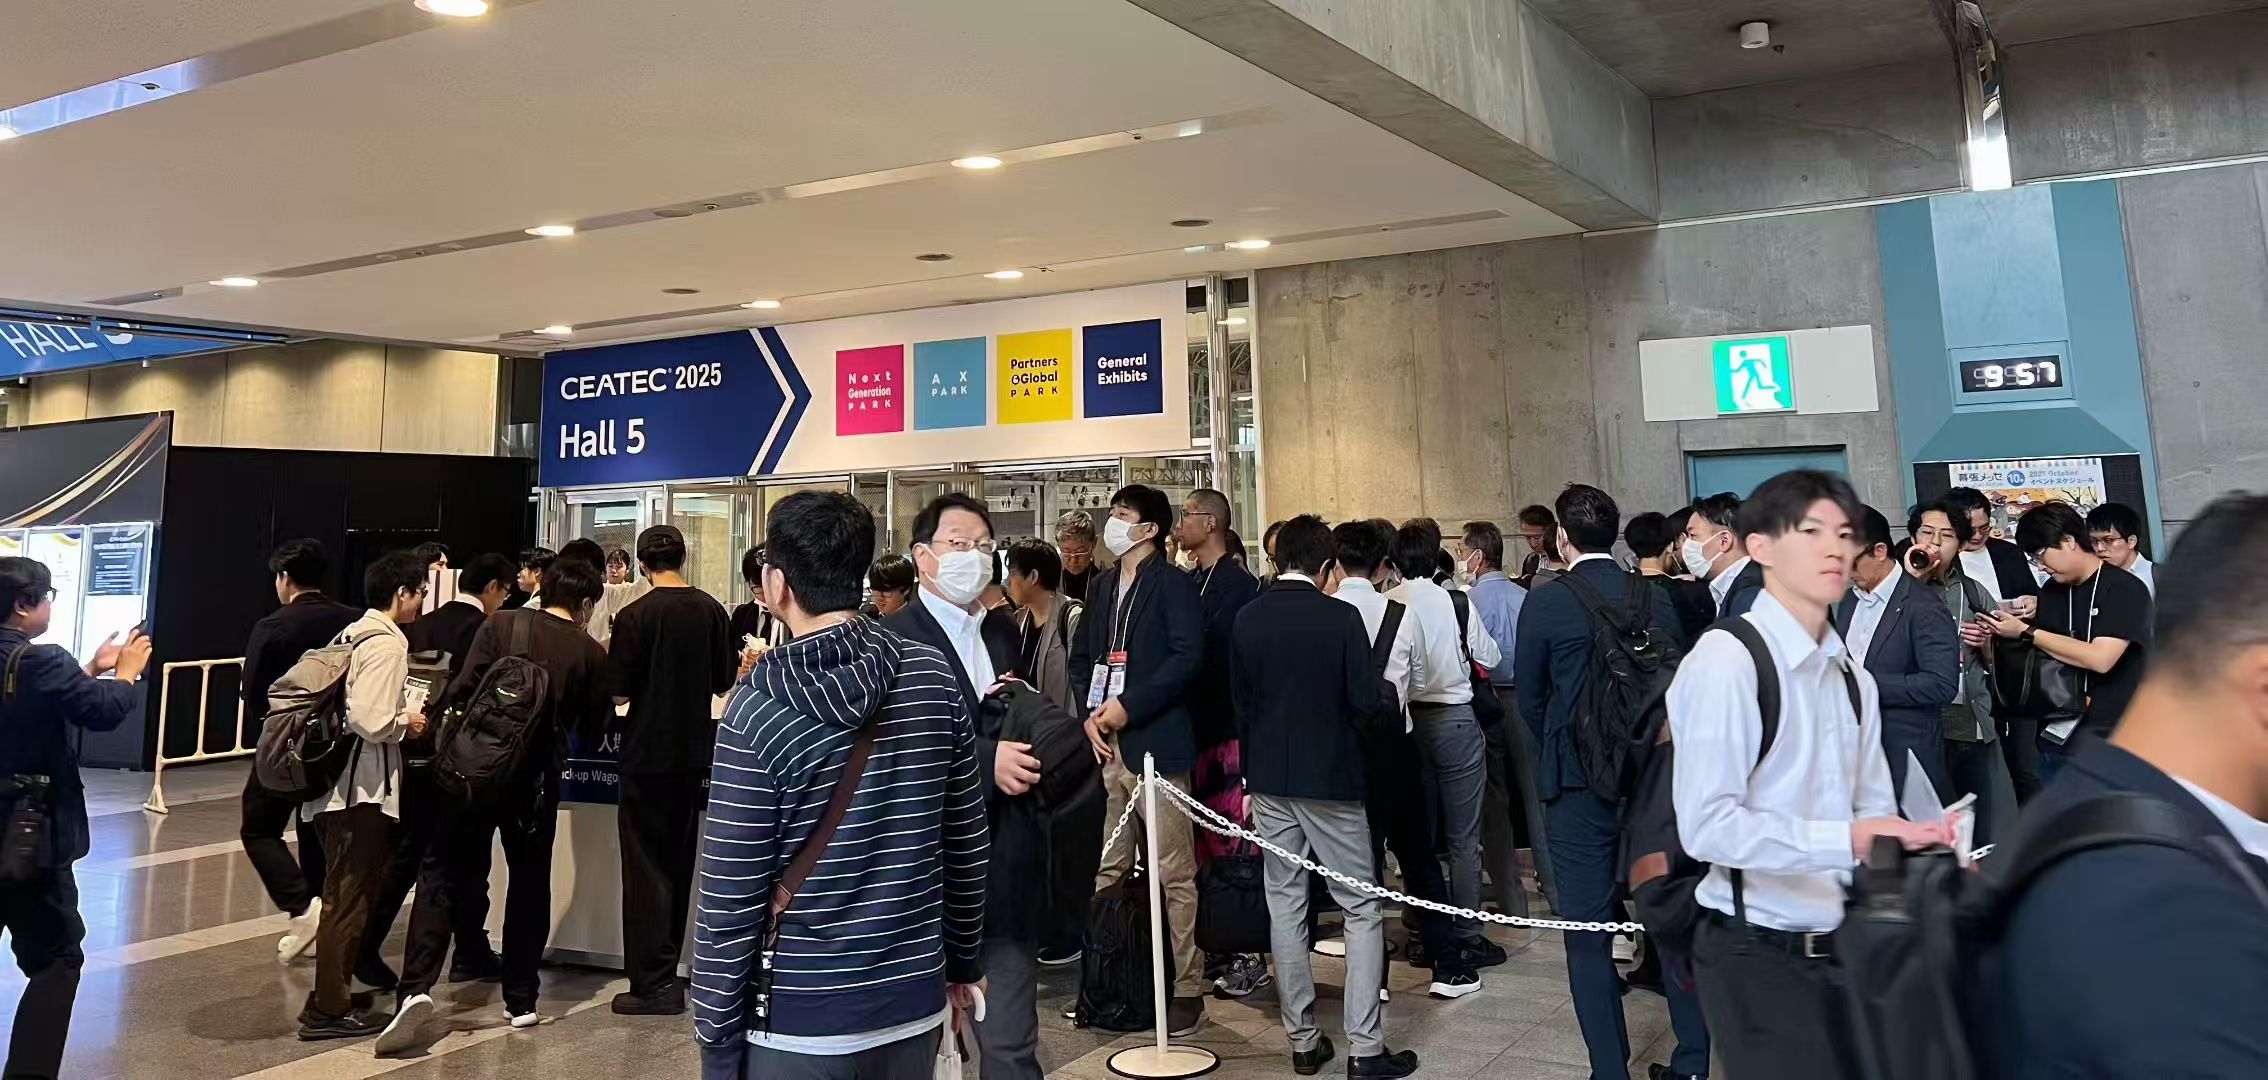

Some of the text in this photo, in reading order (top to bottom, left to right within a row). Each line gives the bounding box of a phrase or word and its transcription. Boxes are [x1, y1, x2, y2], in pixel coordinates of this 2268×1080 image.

[0, 321, 98, 359] HALL
[1010, 357, 1058, 370] Partners
[1097, 353, 1147, 369] General
[560, 363, 722, 400] CEATEC 2025
[848, 371, 892, 385] Next
[1097, 370, 1148, 385] Exhibits
[848, 385, 892, 399] Generation
[932, 385, 968, 397] PARK
[1010, 386, 1058, 397] PARK
[848, 399, 892, 411] PARK
[559, 418, 646, 458] Hall 5
[592, 770, 619, 785] Wago
